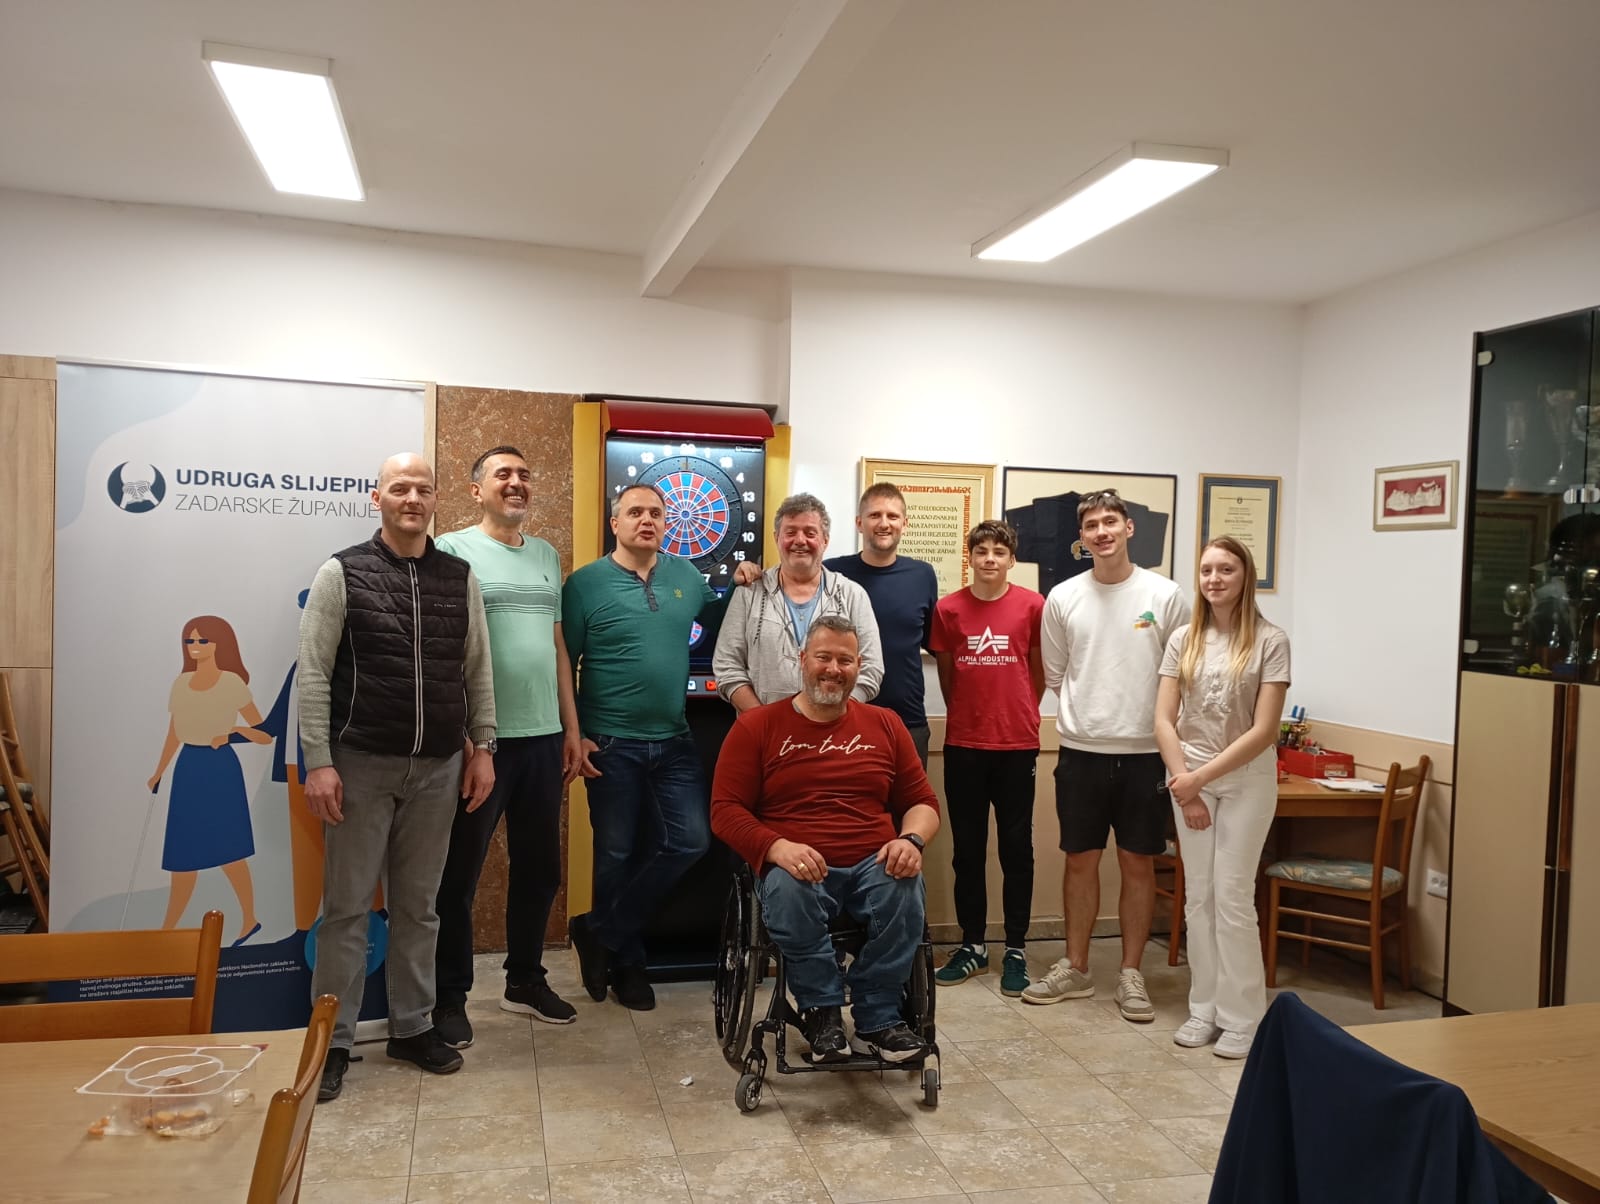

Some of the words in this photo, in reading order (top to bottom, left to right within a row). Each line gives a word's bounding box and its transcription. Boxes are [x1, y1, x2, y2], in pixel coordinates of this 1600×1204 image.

[627, 465, 637, 477] 9
[176, 468, 276, 489] UDRUGA
[281, 474, 378, 493] SLIJEPIH
[736, 472, 745, 483] 4
[743, 492, 755, 502] 13
[175, 494, 283, 515] ZADARSKE
[288, 497, 379, 518] ŽUPANIJE
[748, 512, 756, 522] 6
[742, 532, 755, 543] 10
[733, 551, 745, 561] 15
[719, 565, 727, 575] 2
[701, 574, 711, 584] 7
[978, 655, 1018, 663] INDUSTRIES
[779, 735, 816, 756] tom
[819, 734, 876, 754] tailor
